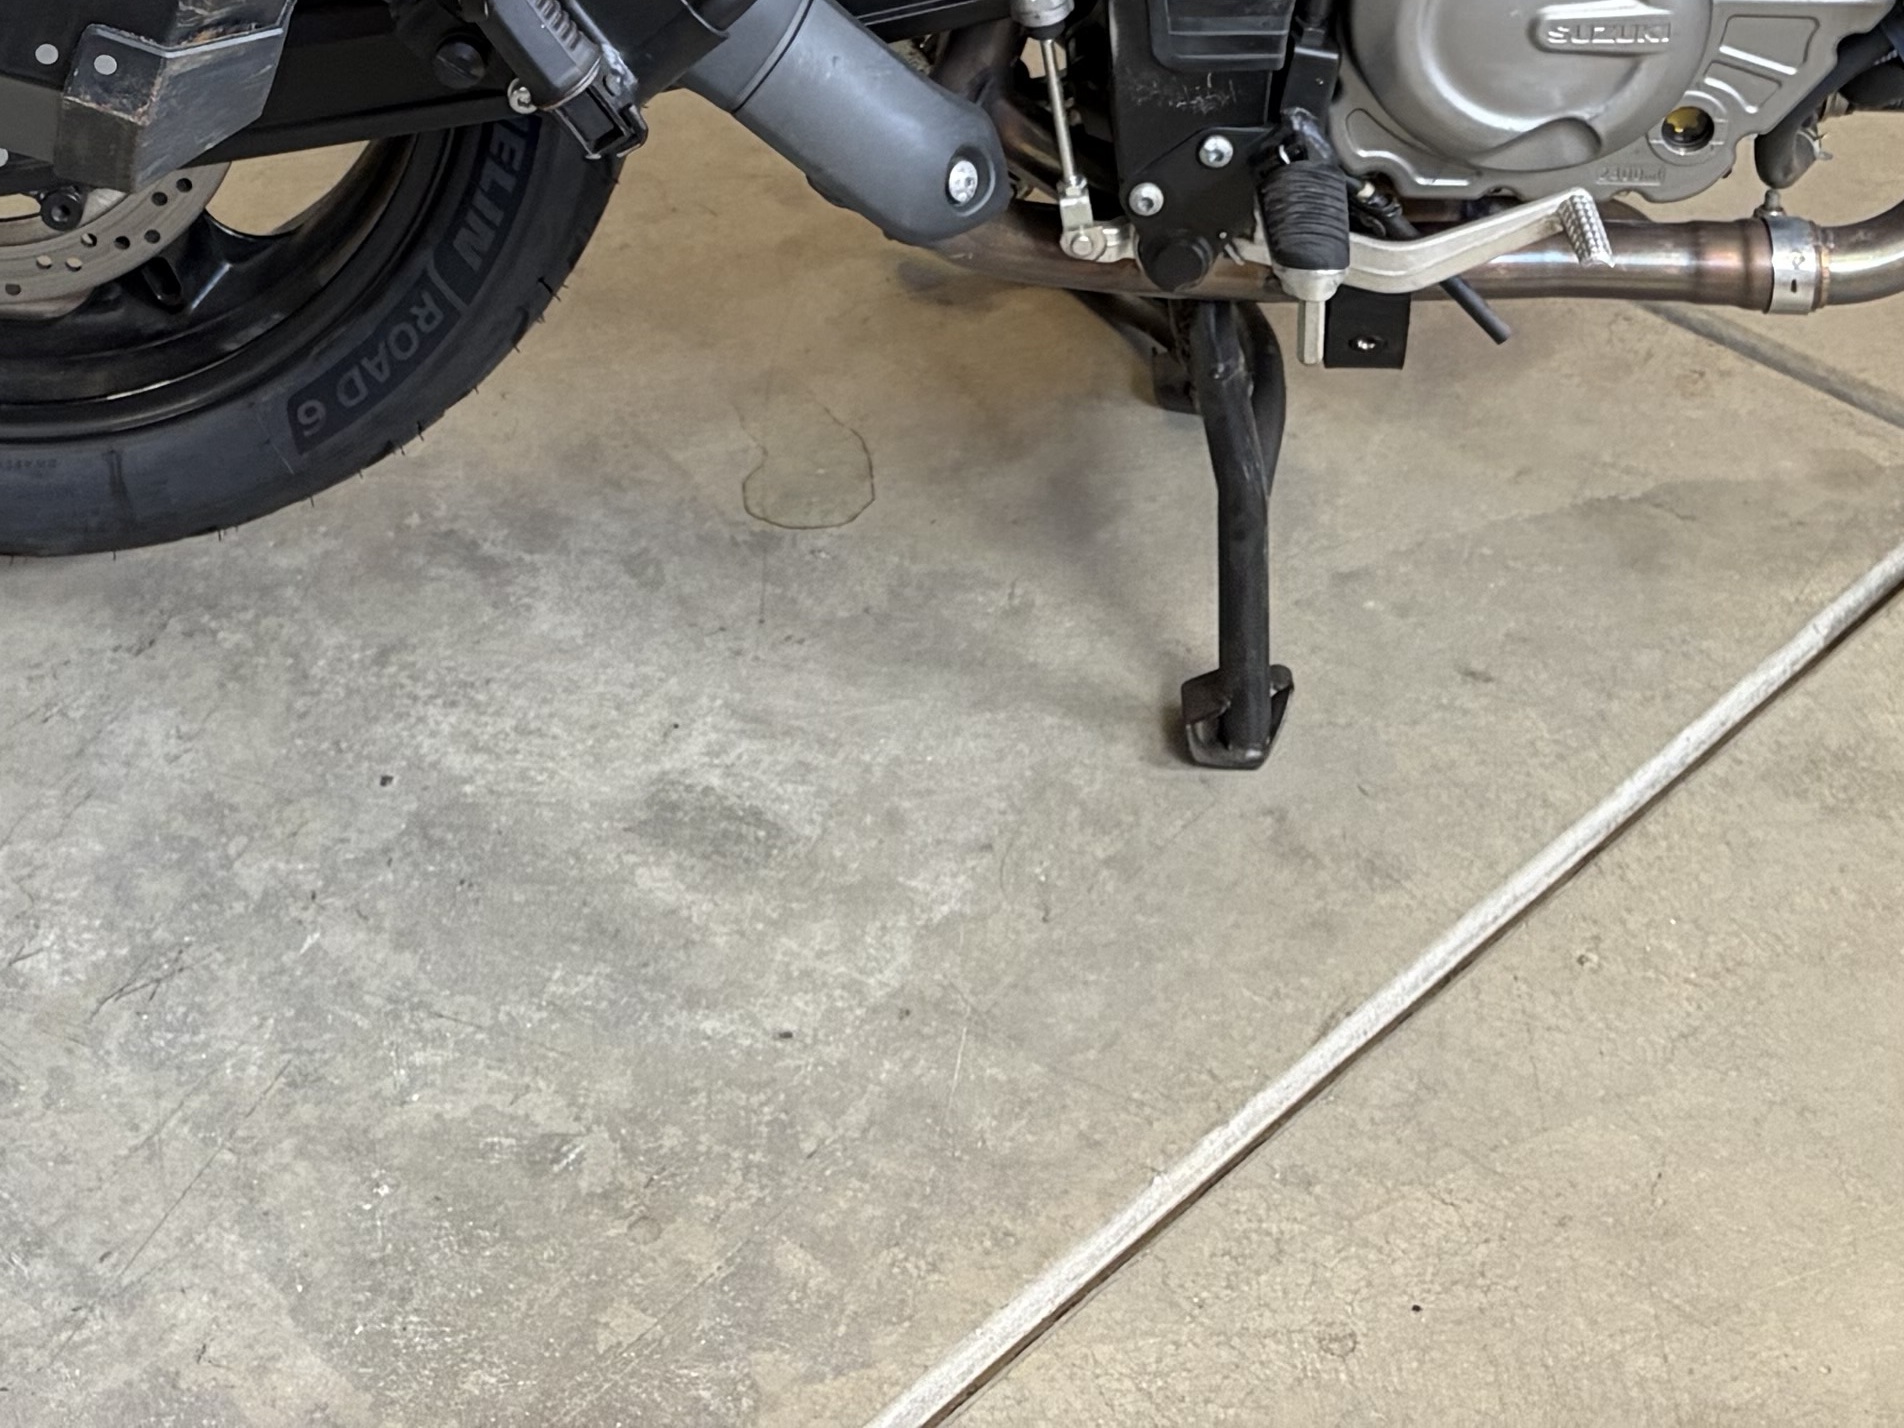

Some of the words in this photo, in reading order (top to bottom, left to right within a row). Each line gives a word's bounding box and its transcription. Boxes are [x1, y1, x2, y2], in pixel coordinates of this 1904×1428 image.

[1547, 21, 1672, 44] SUZUKI
[335, 291, 445, 409] ROAD
[296, 398, 328, 438] 6
